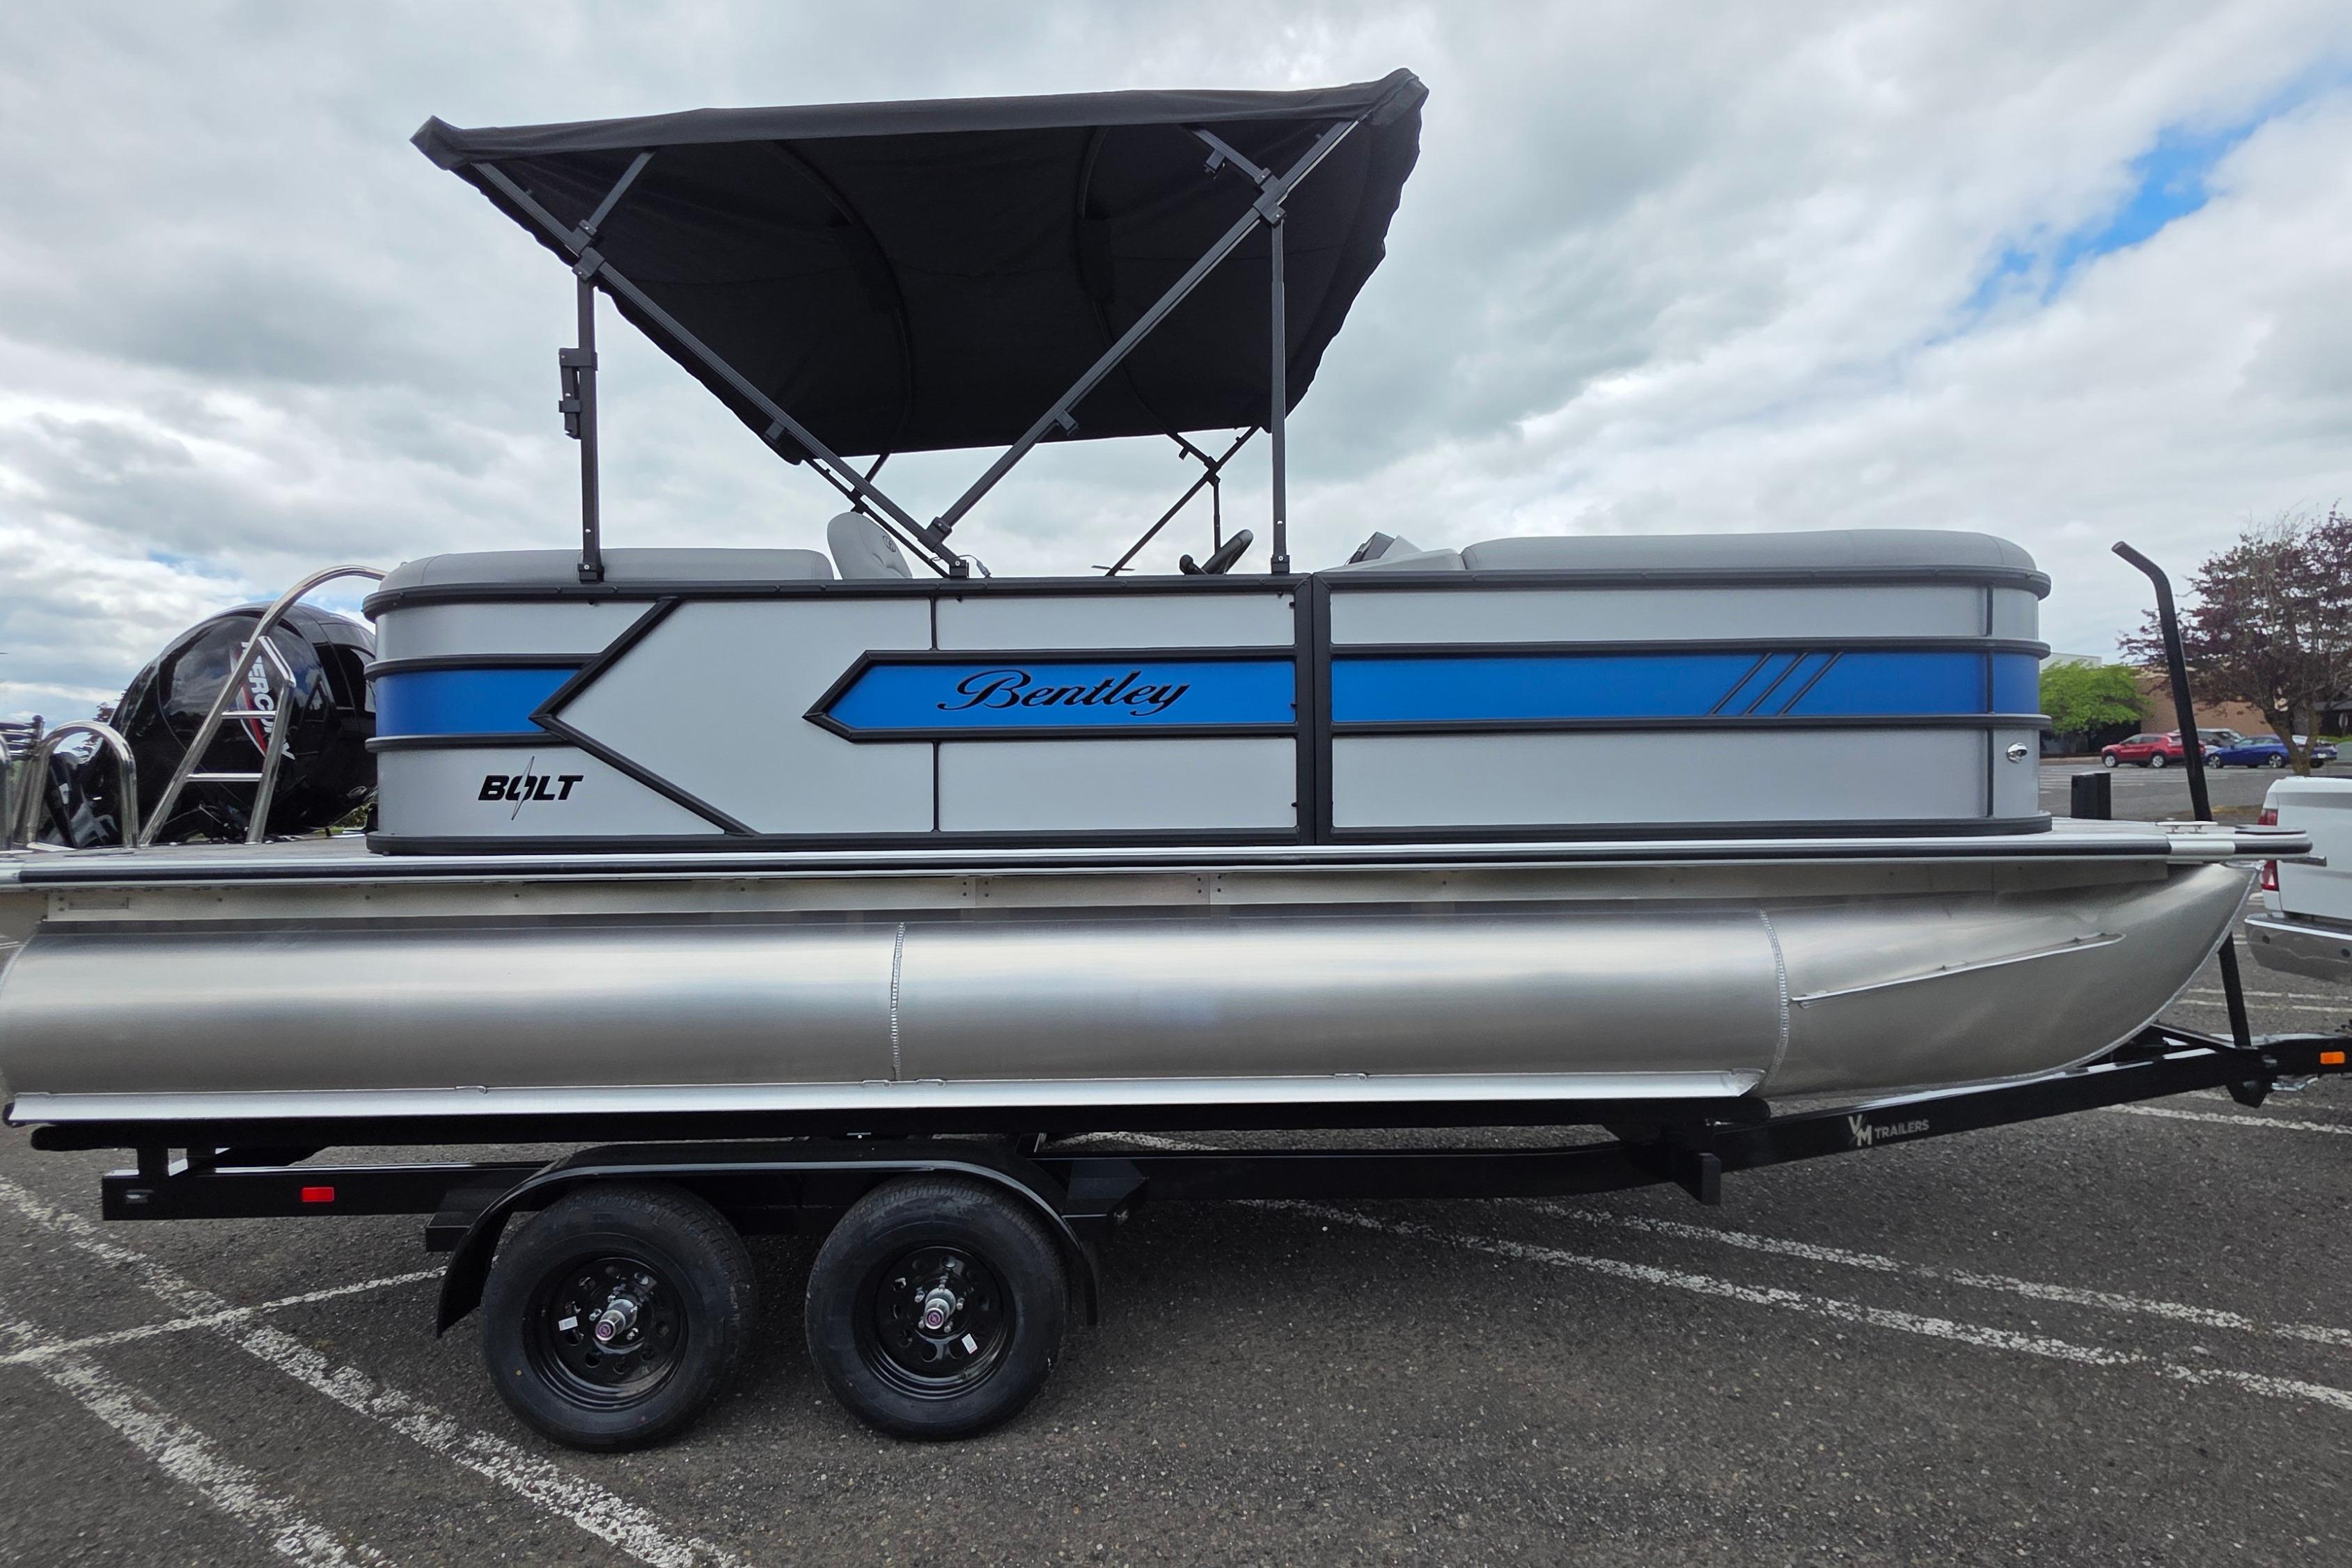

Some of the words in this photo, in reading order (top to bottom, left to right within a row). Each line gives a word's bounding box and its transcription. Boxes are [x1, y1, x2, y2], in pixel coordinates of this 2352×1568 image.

[936, 669, 1191, 716] Bentley
[478, 775, 584, 801] BOLT
[1874, 1119, 1930, 1140] TRAILERS
